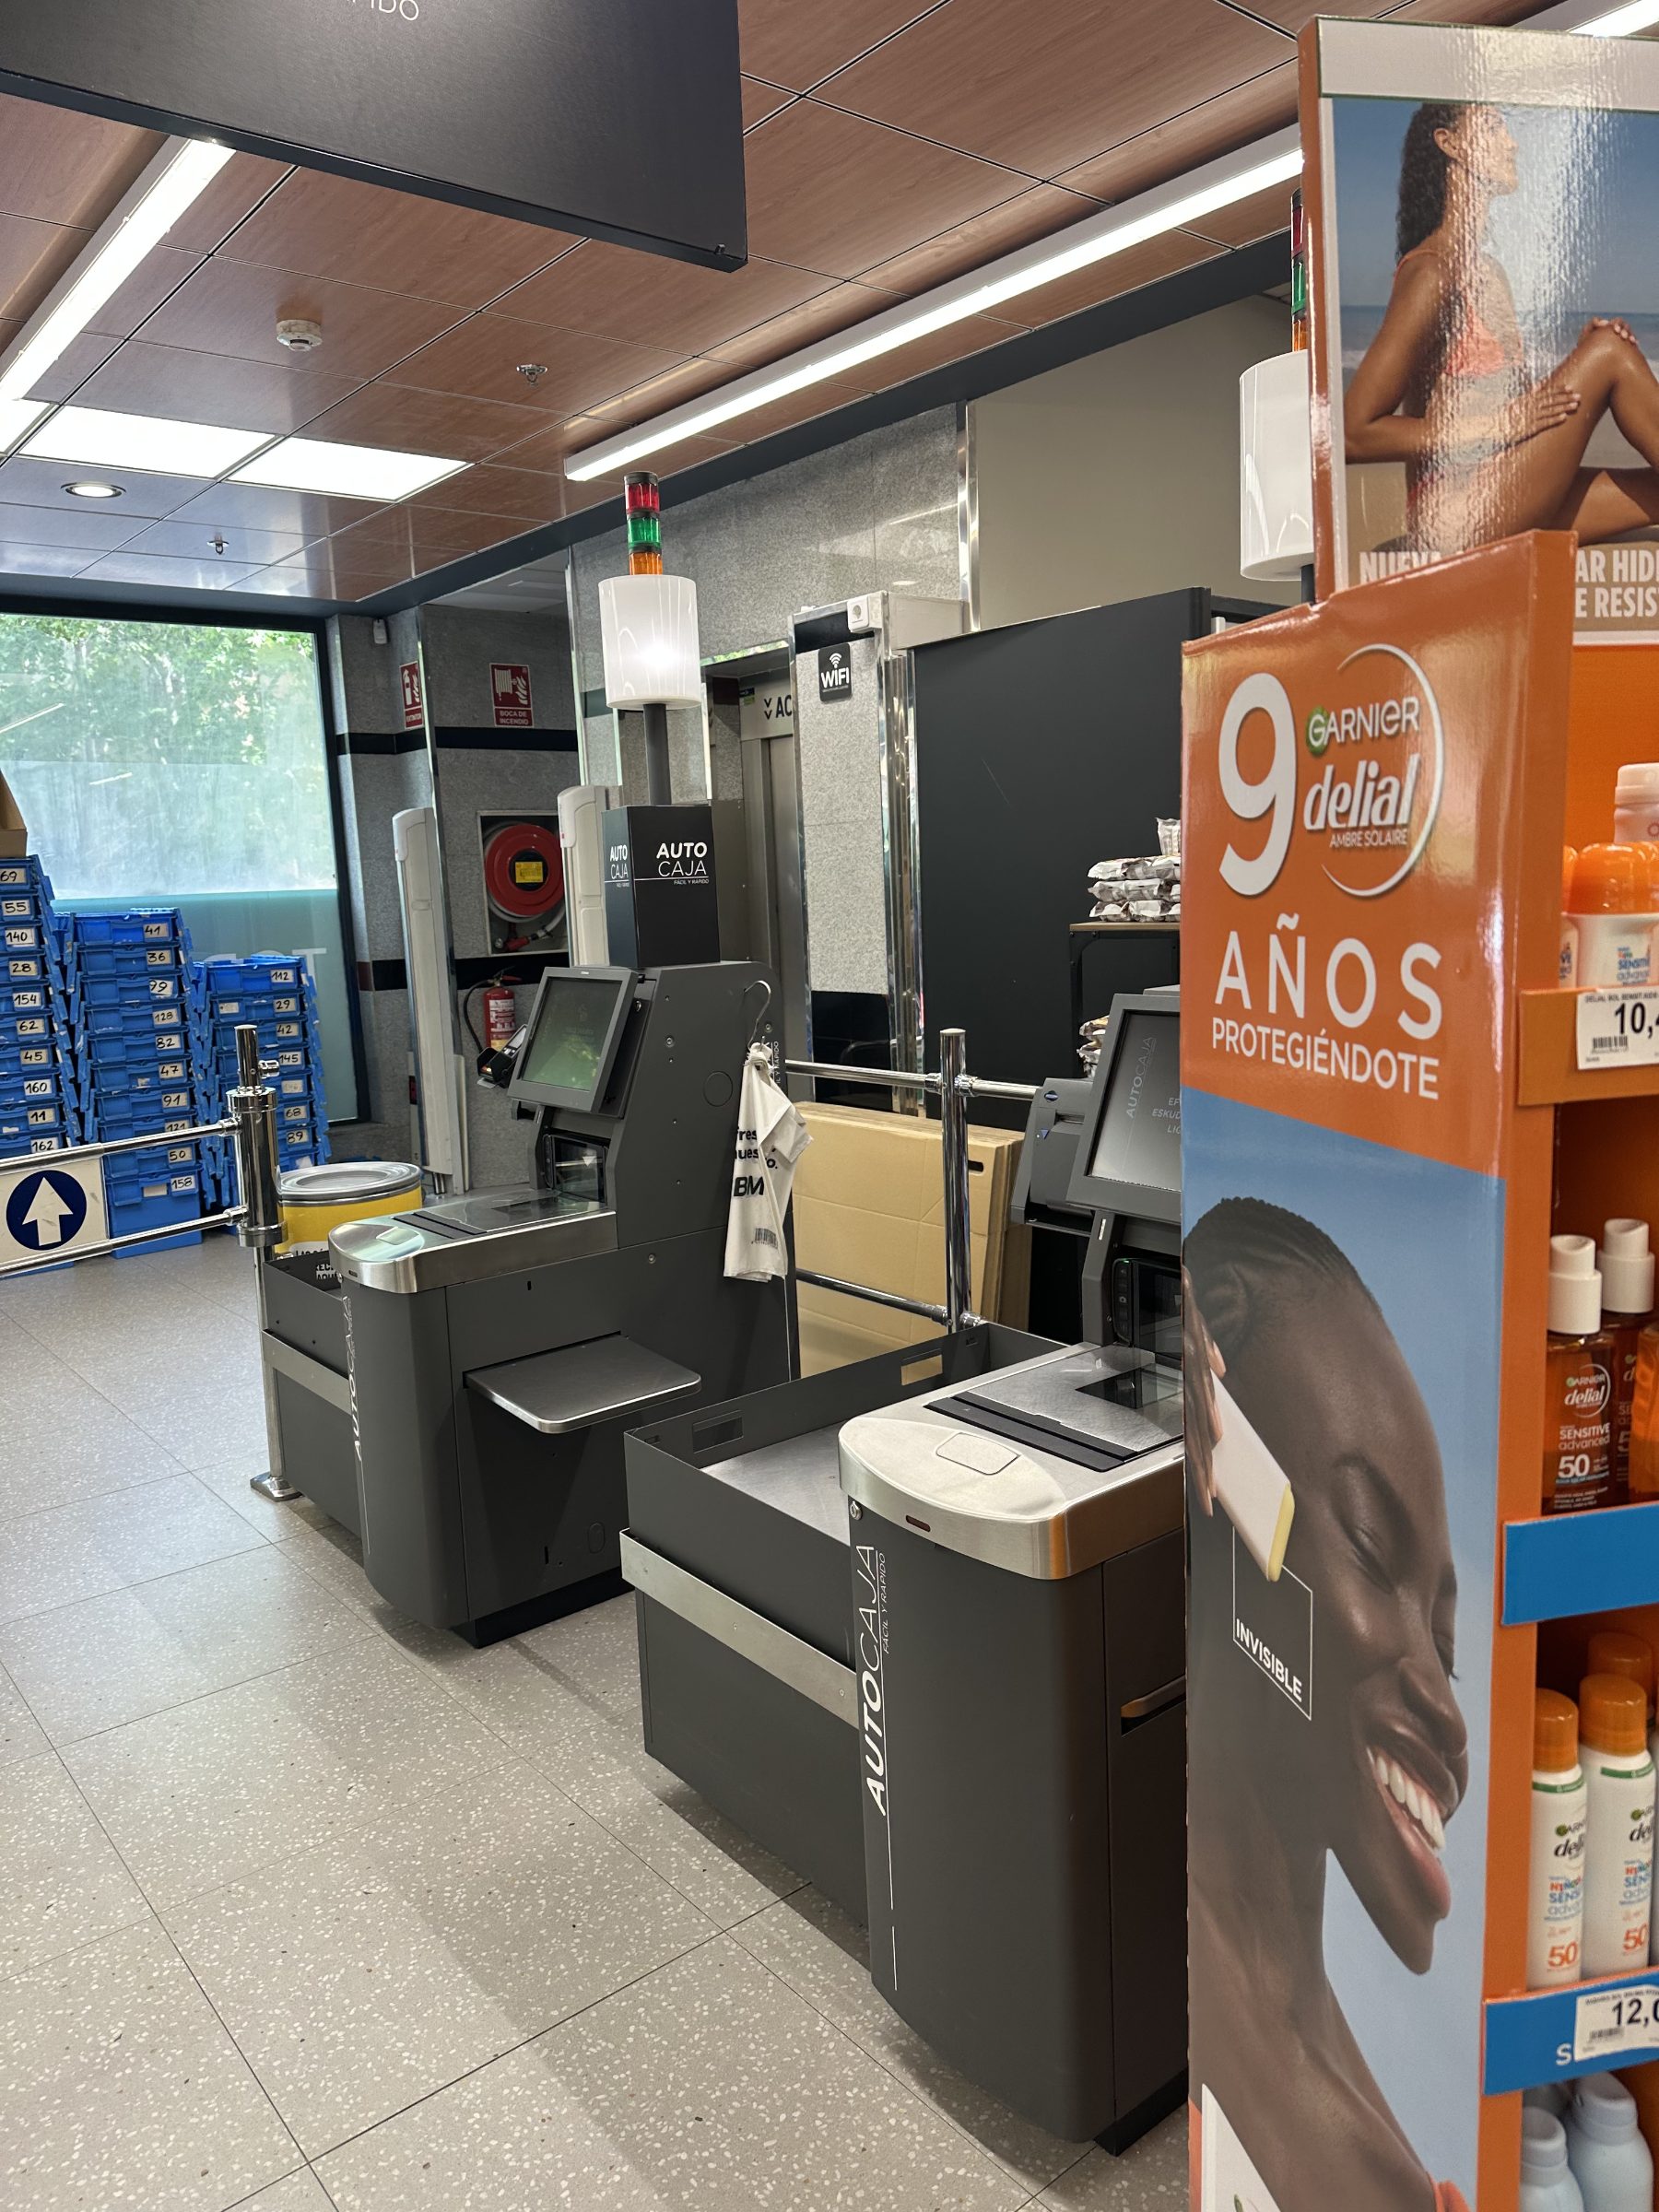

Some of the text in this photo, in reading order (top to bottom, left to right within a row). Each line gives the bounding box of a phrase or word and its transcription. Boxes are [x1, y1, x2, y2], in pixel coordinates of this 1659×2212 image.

[1612, 549, 1659, 582] HID
[1594, 587, 1659, 618] RESIS
[1218, 673, 1297, 896] 9
[1303, 753, 1420, 830] delial
[1330, 829, 1407, 848] AMBRE SOLAIRE
[610, 844, 629, 861] AUTO
[656, 841, 708, 859] AUTO
[611, 863, 629, 879] CAJA
[658, 860, 707, 877] CAJA
[0, 871, 18, 882] 69
[5, 902, 26, 913] 55
[145, 925, 161, 935] 41
[6, 932, 28, 942] 140
[147, 952, 166, 962] 36
[12, 963, 31, 973] 28
[272, 971, 289, 981] 112
[1215, 913, 1442, 1040] AÑOS
[148, 981, 168, 993] 99
[15, 994, 37, 1005] 154
[276, 1000, 290, 1009] 29
[155, 1012, 173, 1022] 128
[19, 1020, 38, 1031] 62
[277, 1025, 292, 1034] 42
[156, 1038, 175, 1049] 82
[24, 1051, 42, 1061] 45
[279, 1053, 299, 1063] 145
[1212, 1017, 1440, 1100] PROTEGIÉNDOTE
[160, 1065, 179, 1076] 47
[26, 1082, 47, 1094] 160
[163, 1095, 181, 1106] 91
[30, 1111, 46, 1122] 11
[286, 1108, 301, 1117] 68
[288, 1131, 303, 1143] 89
[31, 1141, 53, 1152] 162
[170, 1151, 186, 1160] 50
[171, 1178, 193, 1189] 158
[734, 1175, 765, 1197] BM
[1564, 1384, 1606, 1406] delial
[1559, 1422, 1610, 1441] SENSITIVE
[1558, 1435, 1610, 1451] advanced
[1558, 1453, 1591, 1478] 50
[881, 1605, 888, 1613] Y
[1236, 1618, 1303, 1703] INVISIBLE
[1623, 1923, 1648, 1950] 50
[1548, 1940, 1578, 1968] 50
